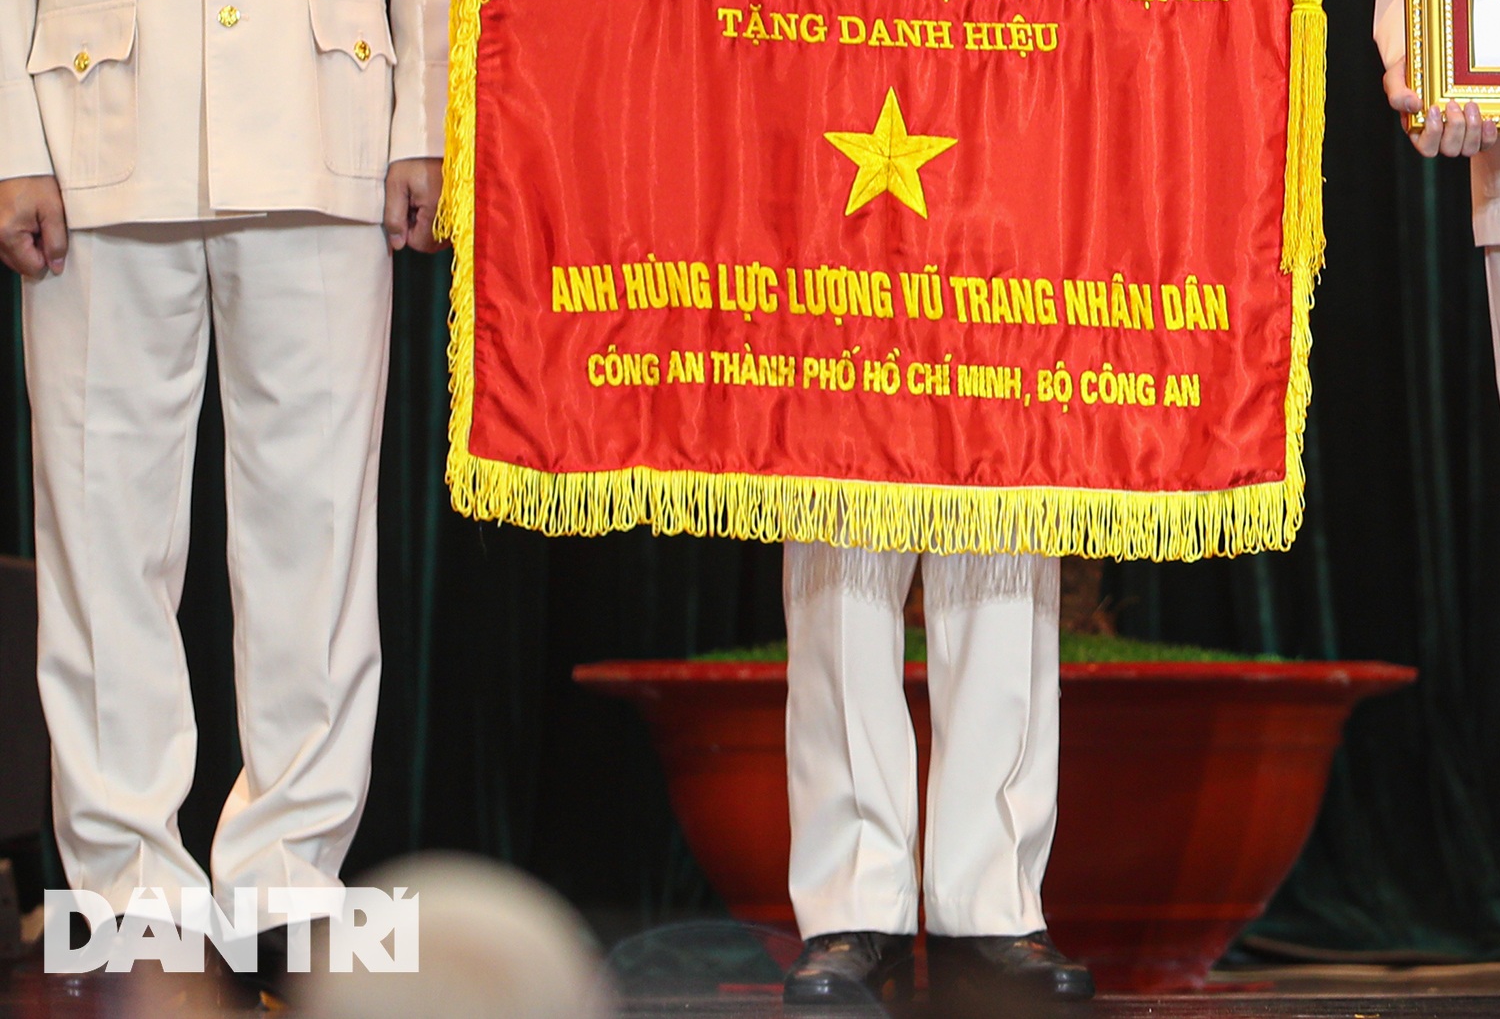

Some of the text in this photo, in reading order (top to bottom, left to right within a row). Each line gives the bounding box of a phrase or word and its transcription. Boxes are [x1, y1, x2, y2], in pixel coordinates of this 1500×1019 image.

[717, 4, 1059, 58] TẶNG DANH HIỆU
[551, 259, 1230, 332] ANH HÙNG LỰC LƯỢNG VŨ TRANG NHÂN DÂN
[587, 342, 1201, 414] CÔNG AN THÀNH PHỐ HỒ CHÍ MINH, BỘ CÔNG AN
